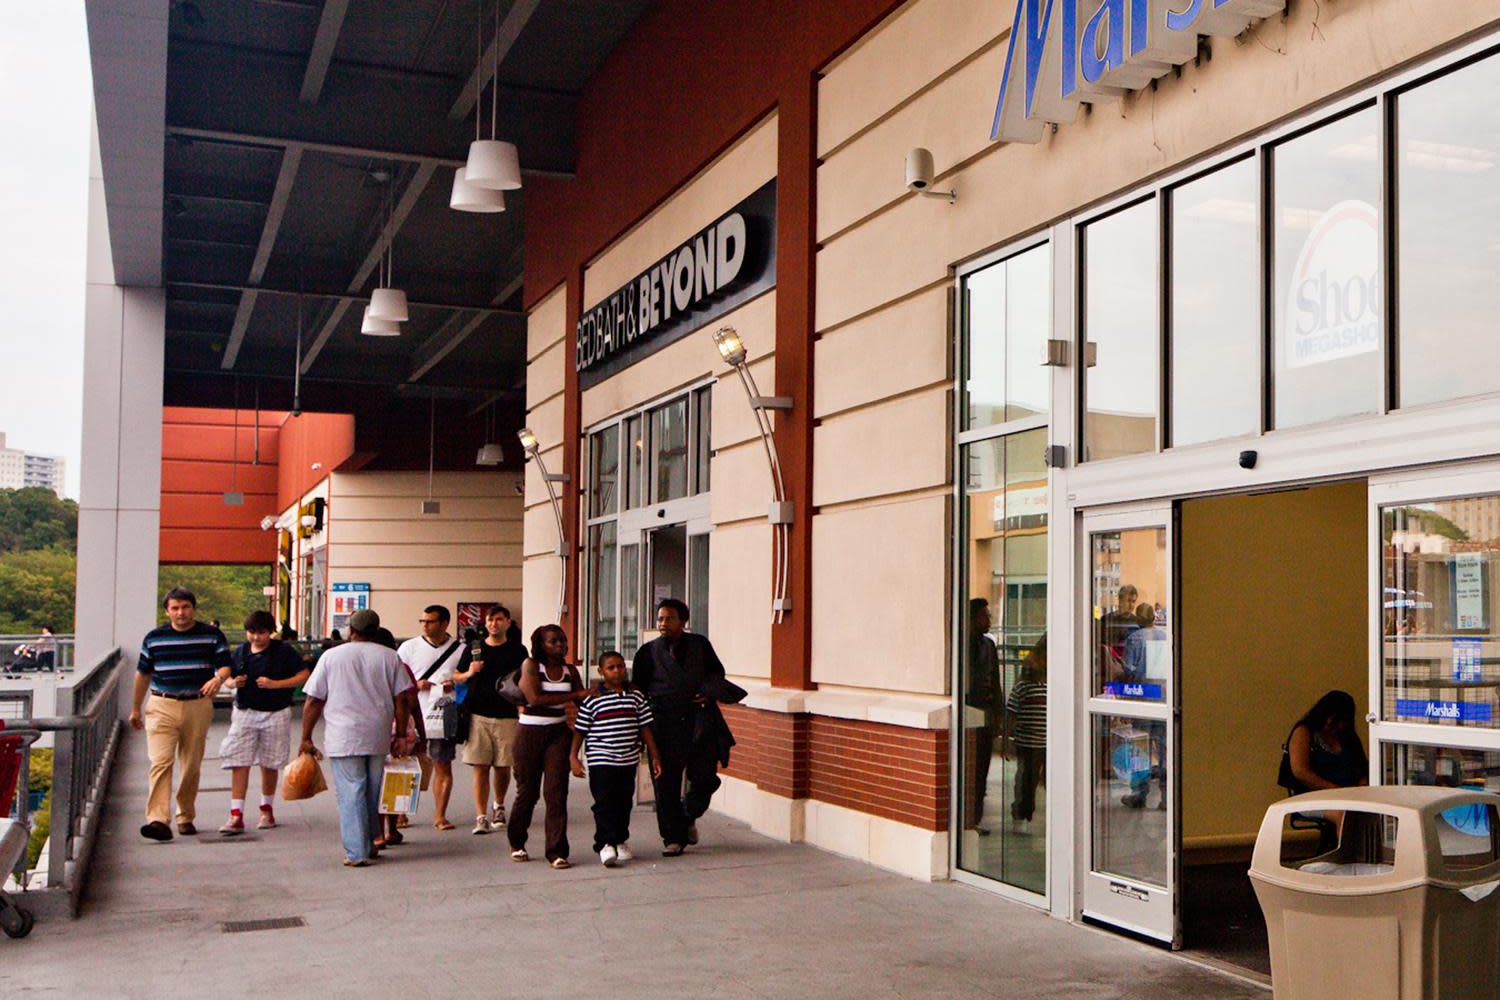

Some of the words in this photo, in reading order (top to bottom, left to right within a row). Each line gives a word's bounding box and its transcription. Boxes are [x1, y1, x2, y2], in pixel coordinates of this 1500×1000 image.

[596, 288, 626, 360] BATH
[639, 212, 747, 336] BEYOND
[1425, 702, 1461, 718] Marshalls
